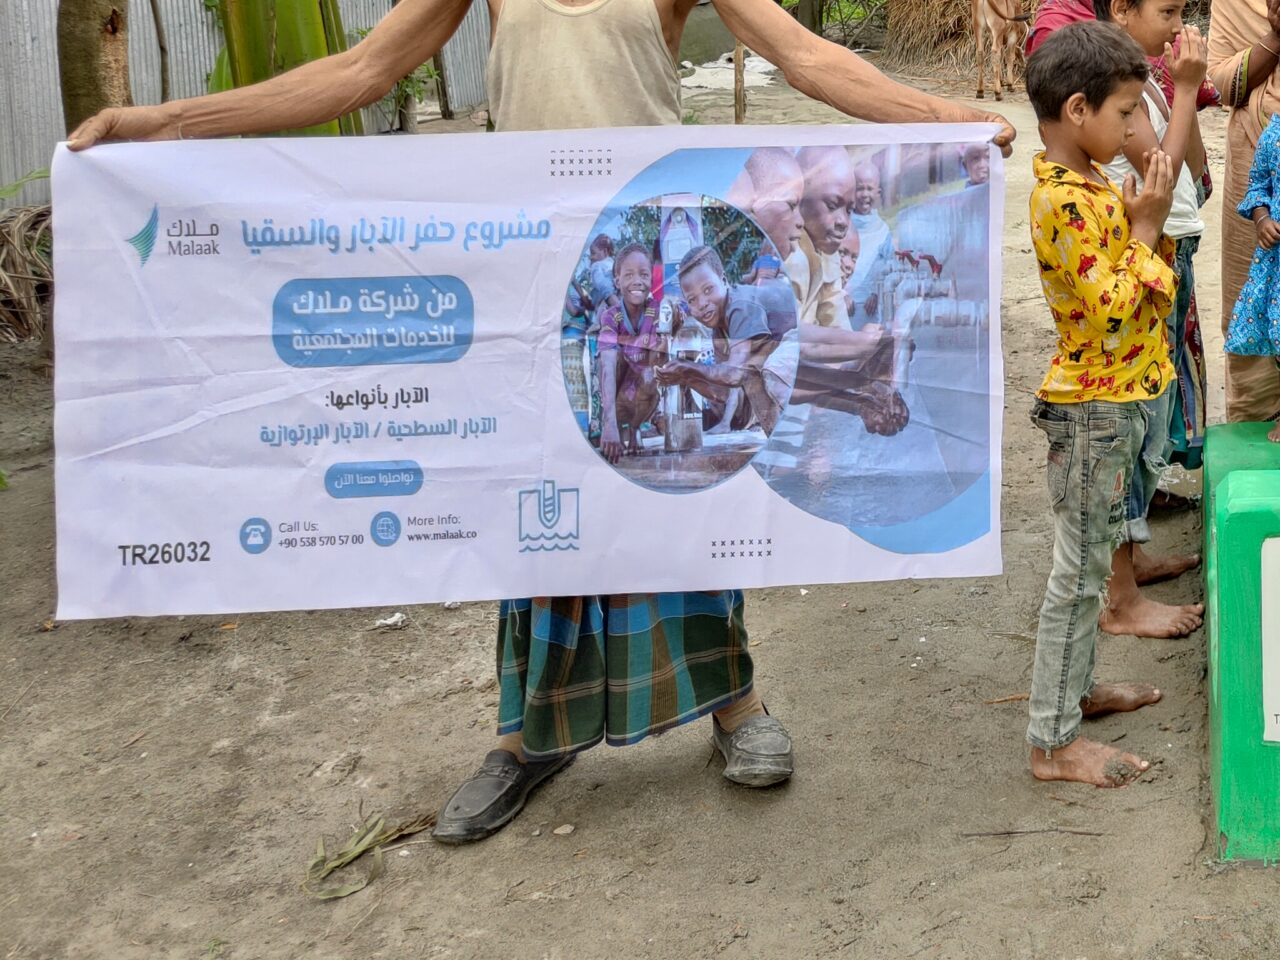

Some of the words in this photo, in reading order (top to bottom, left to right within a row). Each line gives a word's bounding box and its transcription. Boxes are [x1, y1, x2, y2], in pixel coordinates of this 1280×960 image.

[167, 219, 220, 237] ملاك
[241, 218, 341, 254] والسقيا
[344, 216, 405, 253] الآبار
[408, 215, 456, 251] حفر
[463, 208, 552, 252] مشروع
[167, 240, 220, 256] Malaak
[292, 289, 352, 315] ملاك
[358, 283, 420, 320] شركة
[425, 288, 458, 318] من
[292, 327, 378, 356] المجتمعية
[382, 325, 455, 348] للخدمات
[325, 384, 389, 410] بأنواعها:
[392, 387, 430, 409] الآبار
[332, 422, 370, 444] الآبار
[387, 418, 458, 441] السطحية
[459, 416, 498, 439] الآبار
[356, 472, 376, 486] معنا
[378, 471, 415, 487] تواصلوا
[278, 521, 301, 533] Call
[303, 521, 319, 532] Us:
[407, 516, 434, 526] More
[437, 514, 461, 526] Info:
[278, 537, 298, 549] +90
[299, 536, 317, 548] 538
[319, 535, 337, 546] 570
[338, 535, 350, 545] 57
[351, 534, 365, 545] 00
[407, 529, 478, 542] www.malaak.co
[118, 541, 211, 567] TR26032
